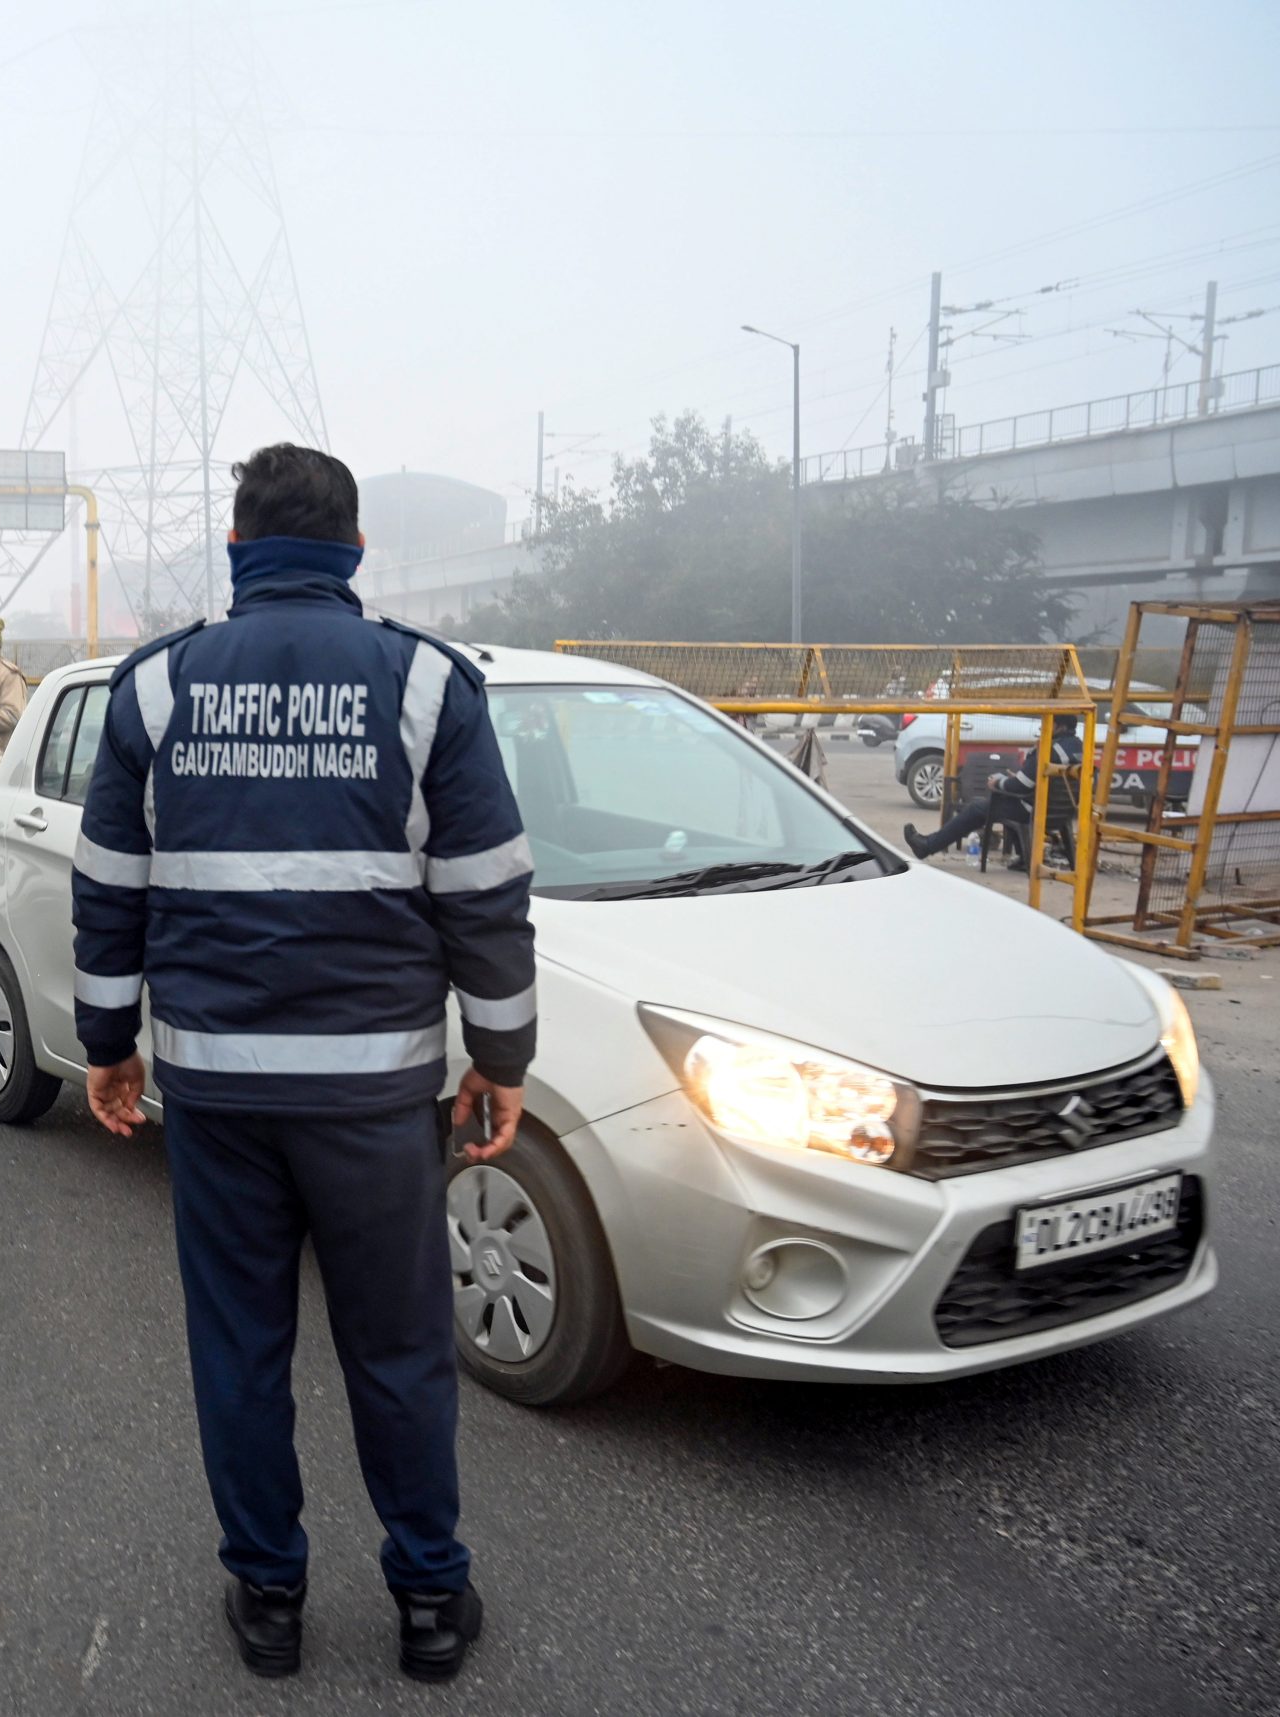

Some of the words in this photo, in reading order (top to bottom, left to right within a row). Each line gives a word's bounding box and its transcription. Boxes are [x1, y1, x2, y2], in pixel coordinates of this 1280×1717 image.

[189, 683, 282, 737] TRAFFIC
[287, 683, 368, 737] POLICE
[171, 741, 308, 778] GAUTAMBUDDH
[313, 743, 378, 780] NAGAR
